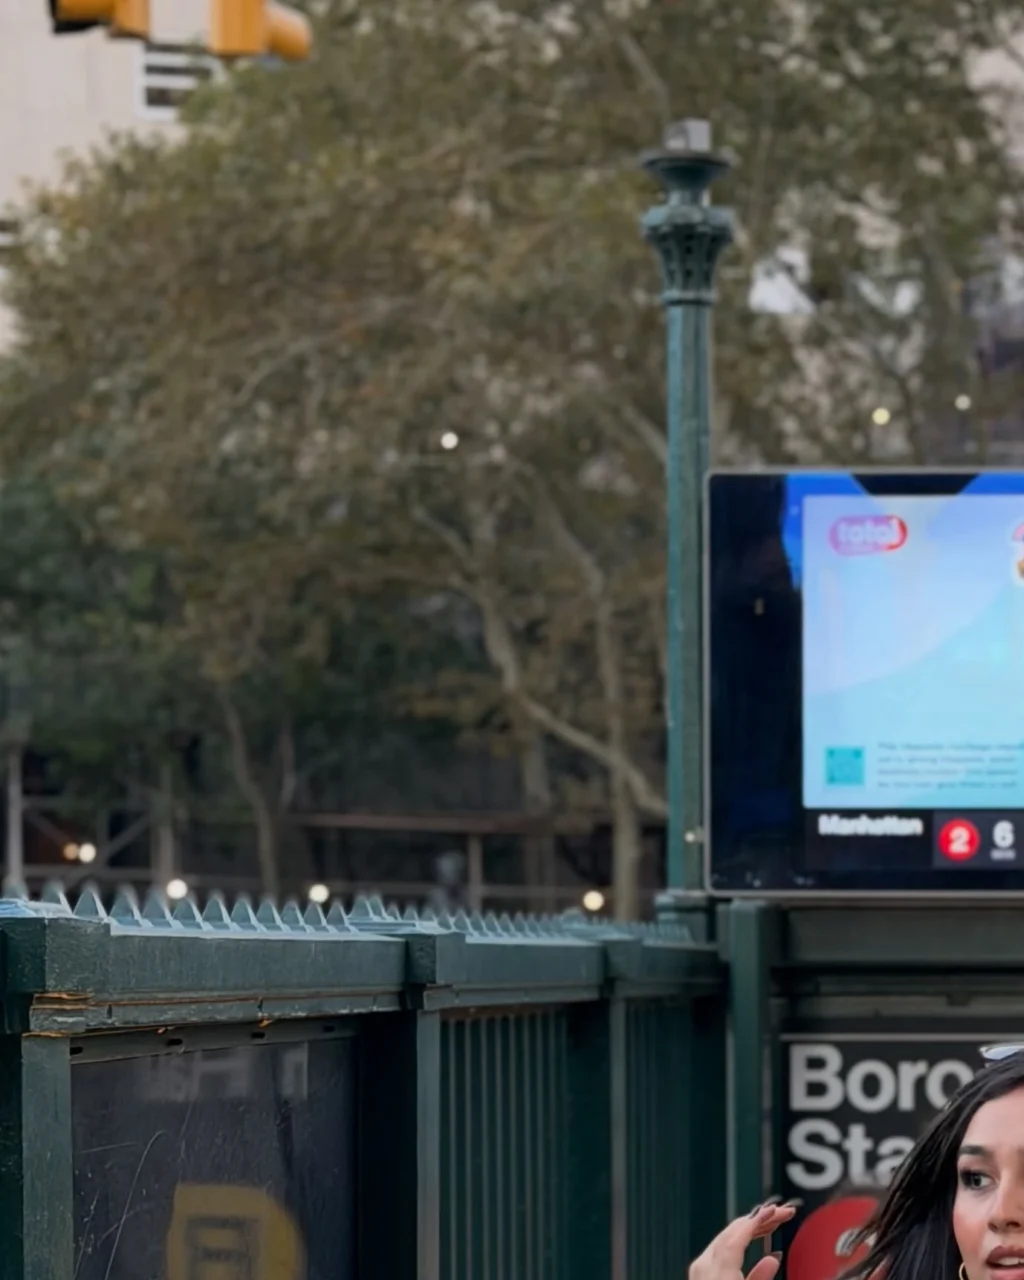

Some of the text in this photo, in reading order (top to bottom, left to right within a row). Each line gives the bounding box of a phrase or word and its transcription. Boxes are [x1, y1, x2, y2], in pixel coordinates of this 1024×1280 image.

[948, 826, 970, 853] 2
[992, 820, 1014, 849] 6
[789, 1043, 976, 1113] Boro
